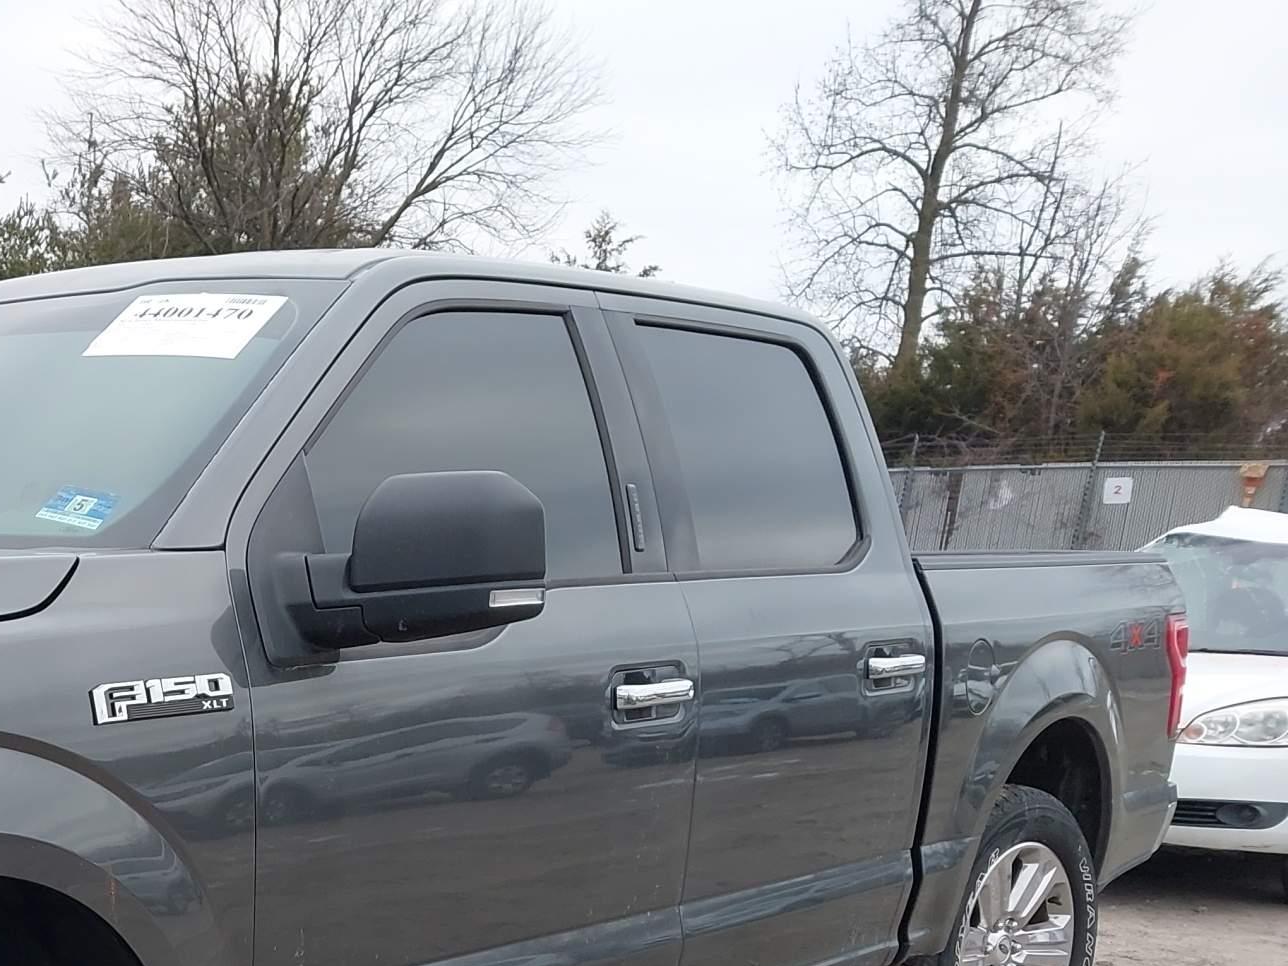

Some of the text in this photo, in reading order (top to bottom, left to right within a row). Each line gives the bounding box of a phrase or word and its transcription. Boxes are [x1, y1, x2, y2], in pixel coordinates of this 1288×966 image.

[134, 306, 254, 321] 44001470
[1113, 485, 1122, 495] 2
[73, 498, 89, 512] 5
[201, 698, 229, 710] XLT
